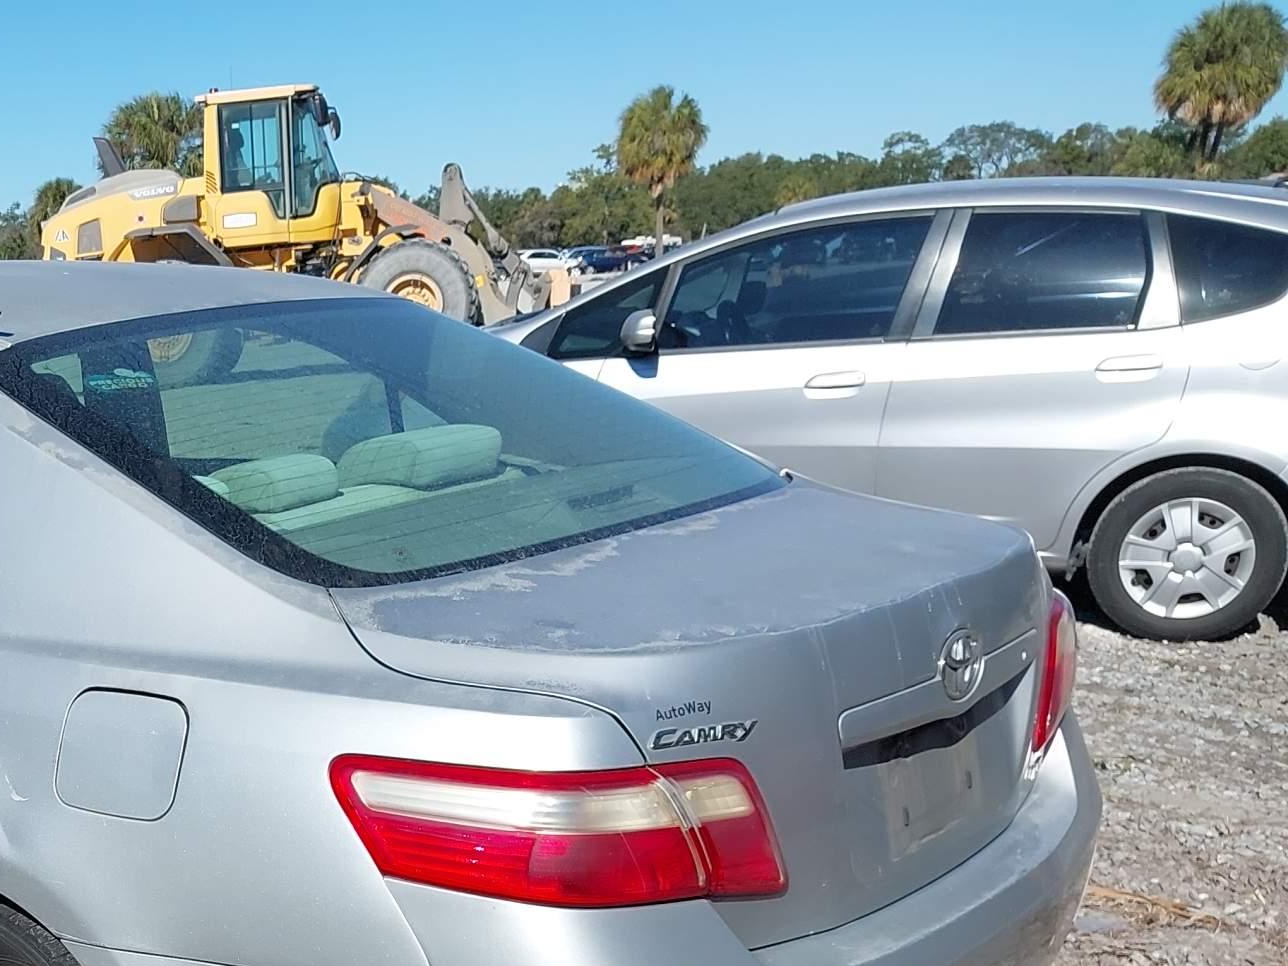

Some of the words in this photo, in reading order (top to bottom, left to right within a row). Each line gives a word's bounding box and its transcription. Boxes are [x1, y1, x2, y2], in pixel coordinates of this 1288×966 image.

[133, 185, 175, 198] VOLVO
[655, 700, 712, 721] AutoWay
[648, 718, 759, 751] CAMRY
